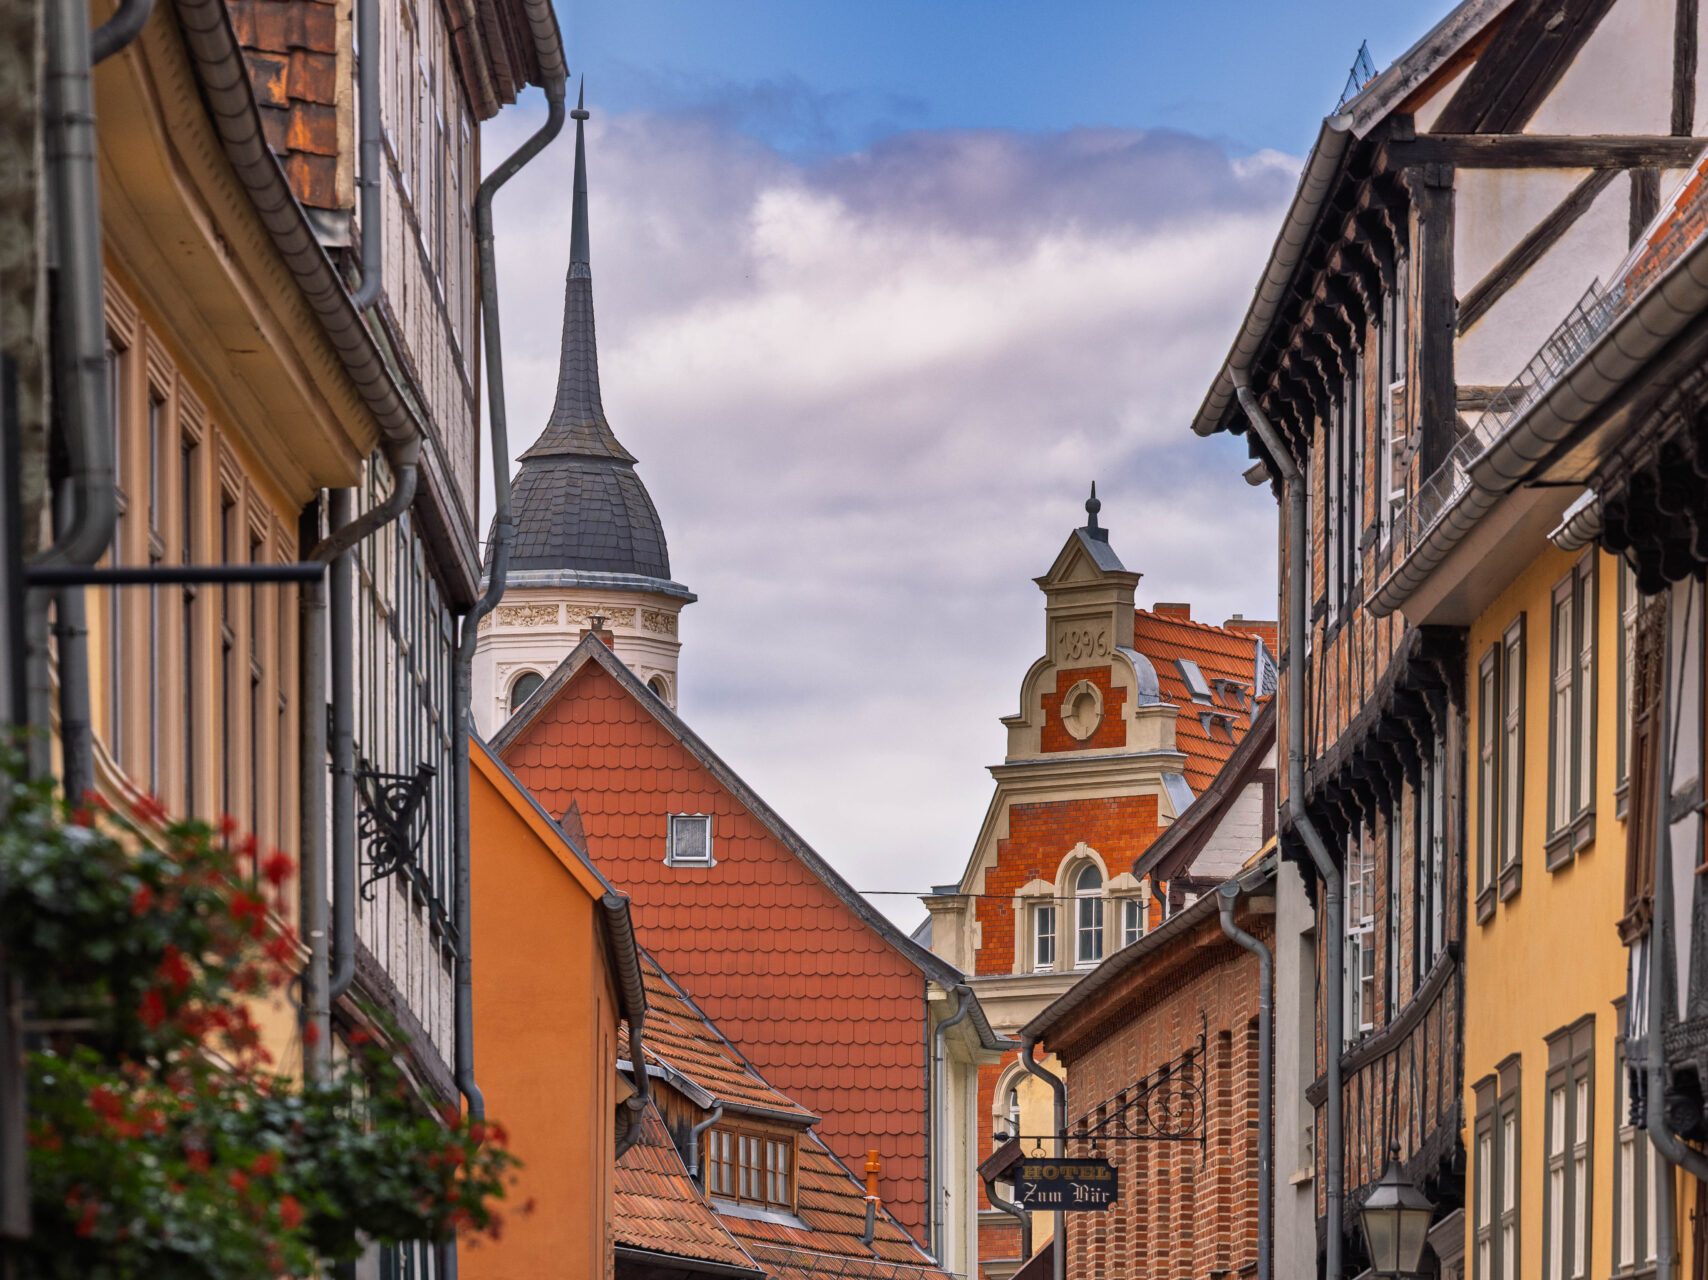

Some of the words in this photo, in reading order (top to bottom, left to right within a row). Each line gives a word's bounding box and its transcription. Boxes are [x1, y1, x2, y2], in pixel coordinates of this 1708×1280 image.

[1022, 1165, 1112, 1180] HOTEL
[1023, 1182, 1062, 1203] Zum
[1068, 1182, 1111, 1203] Bär
